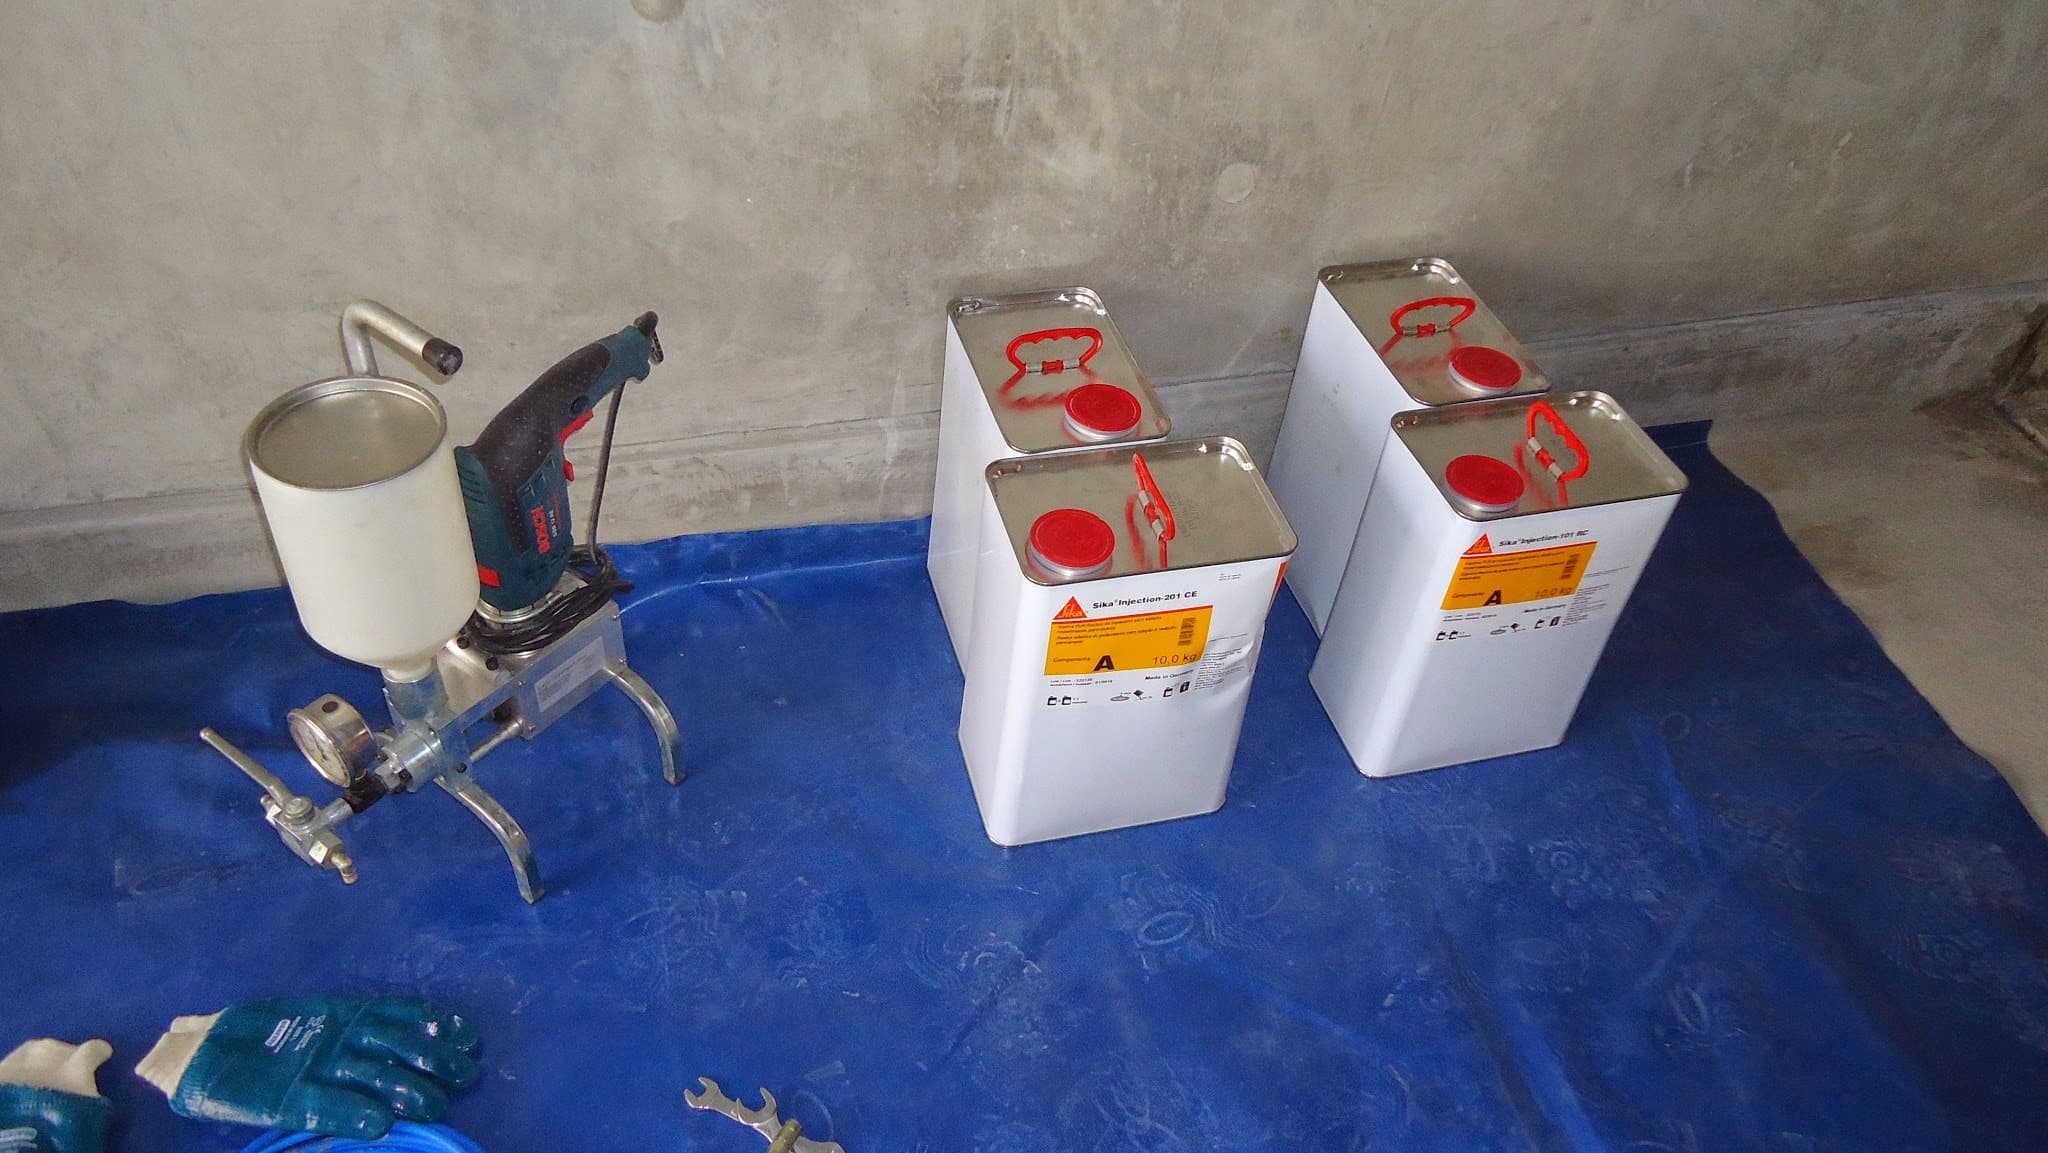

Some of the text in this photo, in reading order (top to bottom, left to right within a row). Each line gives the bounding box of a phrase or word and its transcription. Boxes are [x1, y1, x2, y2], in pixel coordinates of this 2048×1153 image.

[1118, 593, 1181, 607] Injection-201
[1184, 590, 1198, 598] CE
[1483, 589, 1502, 606] A
[1060, 603, 1083, 618] Sika
[1093, 655, 1115, 671] A
[1182, 653, 1197, 664] kg
